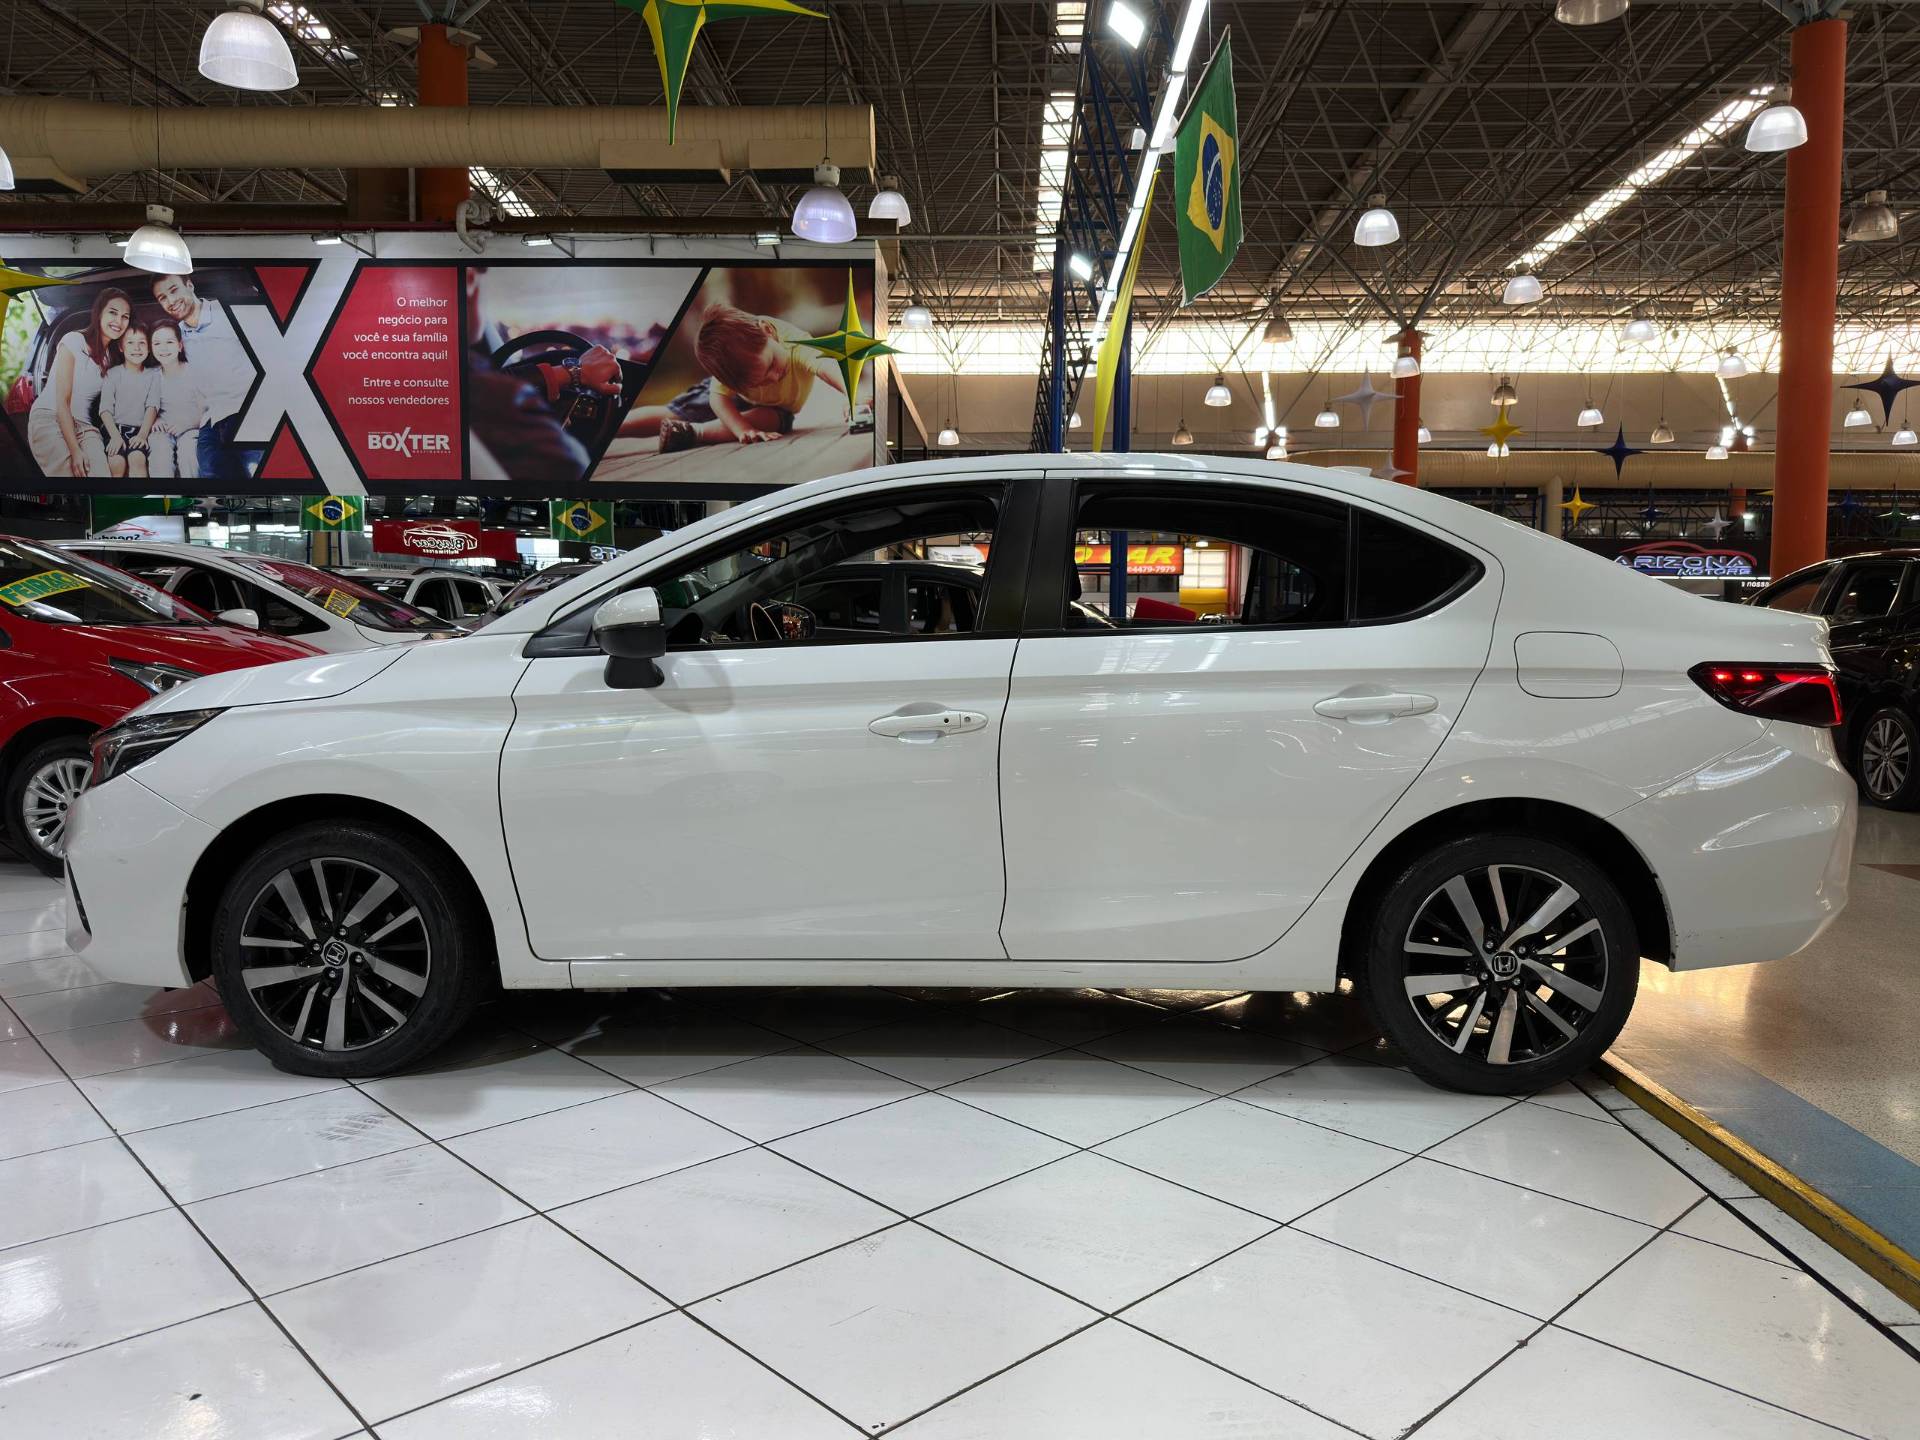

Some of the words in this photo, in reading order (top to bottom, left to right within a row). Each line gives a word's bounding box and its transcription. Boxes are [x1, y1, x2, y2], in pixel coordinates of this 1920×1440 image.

[396, 296, 407, 307] O
[409, 297, 448, 307] melhor
[378, 315, 421, 326] negócio
[424, 316, 448, 327] para
[353, 332, 380, 342] você
[382, 334, 389, 342] e
[391, 334, 410, 342] sua
[413, 332, 448, 342] família
[342, 350, 369, 360] você
[371, 351, 419, 360] encontra
[422, 350, 448, 362] aqui!
[363, 377, 391, 387] Entre
[403, 377, 449, 387] consulte
[348, 396, 385, 405] nossos
[387, 395, 450, 405] vendedores
[367, 426, 451, 458] BOXTER
[1613, 555, 1751, 568] ARIZONA
